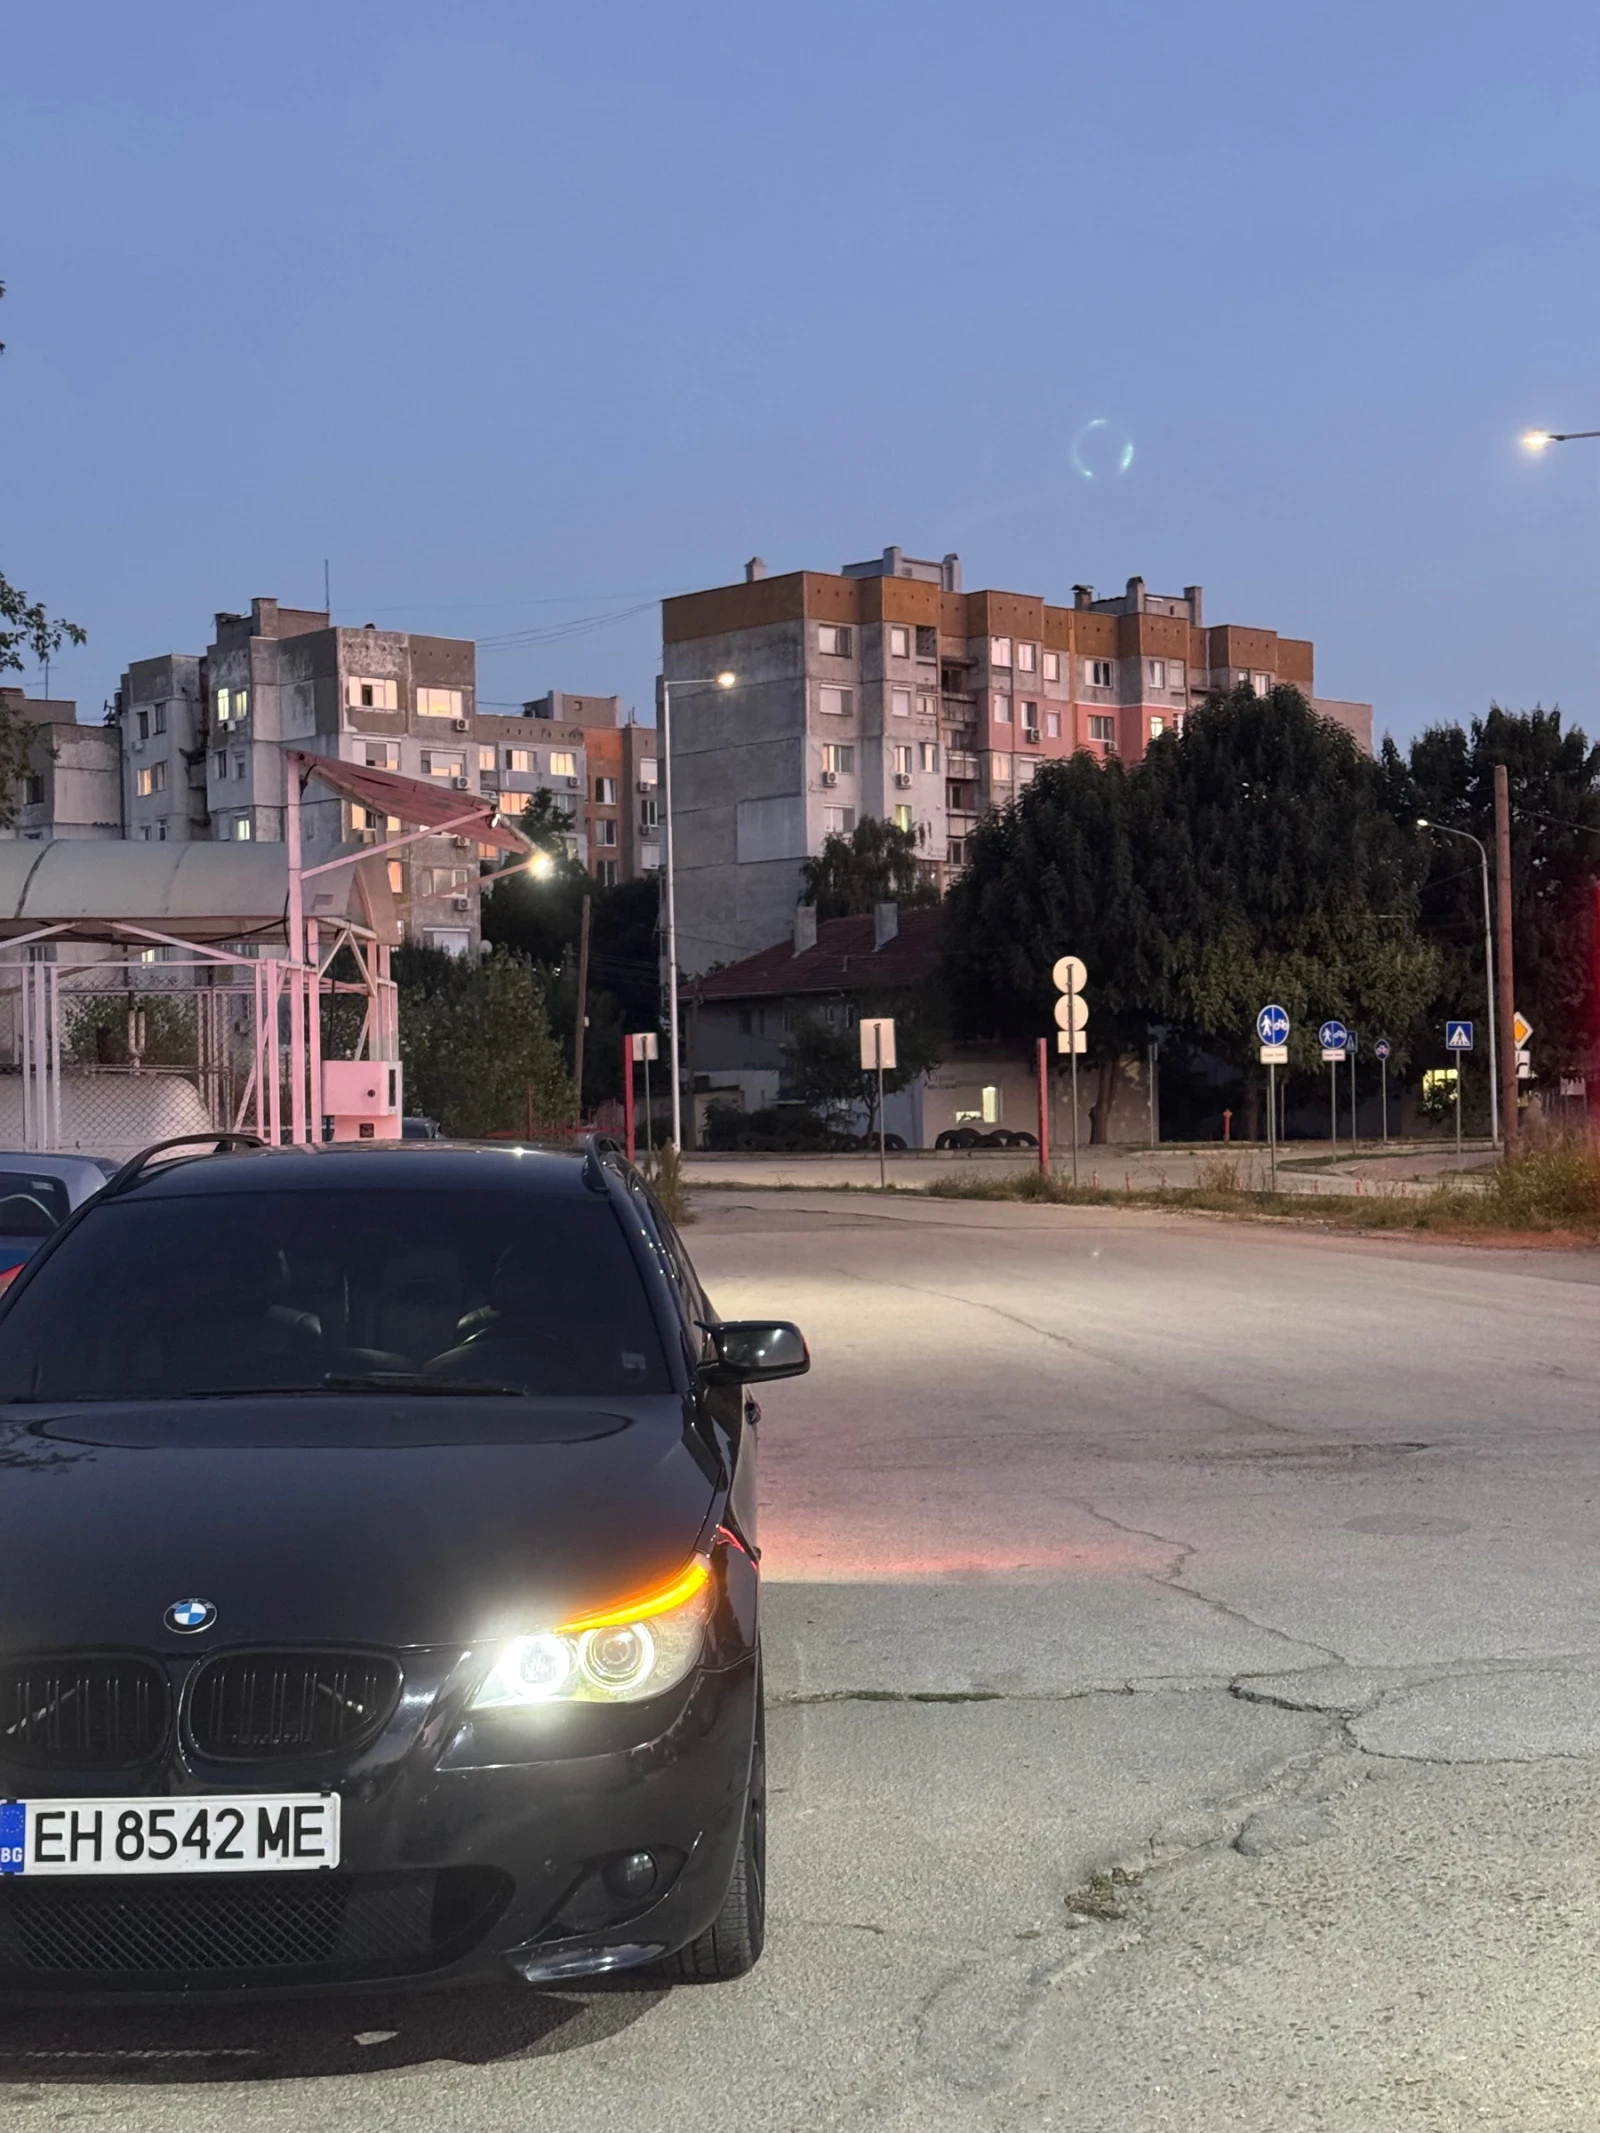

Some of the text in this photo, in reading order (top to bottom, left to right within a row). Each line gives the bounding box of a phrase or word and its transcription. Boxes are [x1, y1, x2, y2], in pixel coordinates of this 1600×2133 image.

[35, 1805, 325, 1863] EH 8542 ME
[0, 1846, 23, 1863] BG
